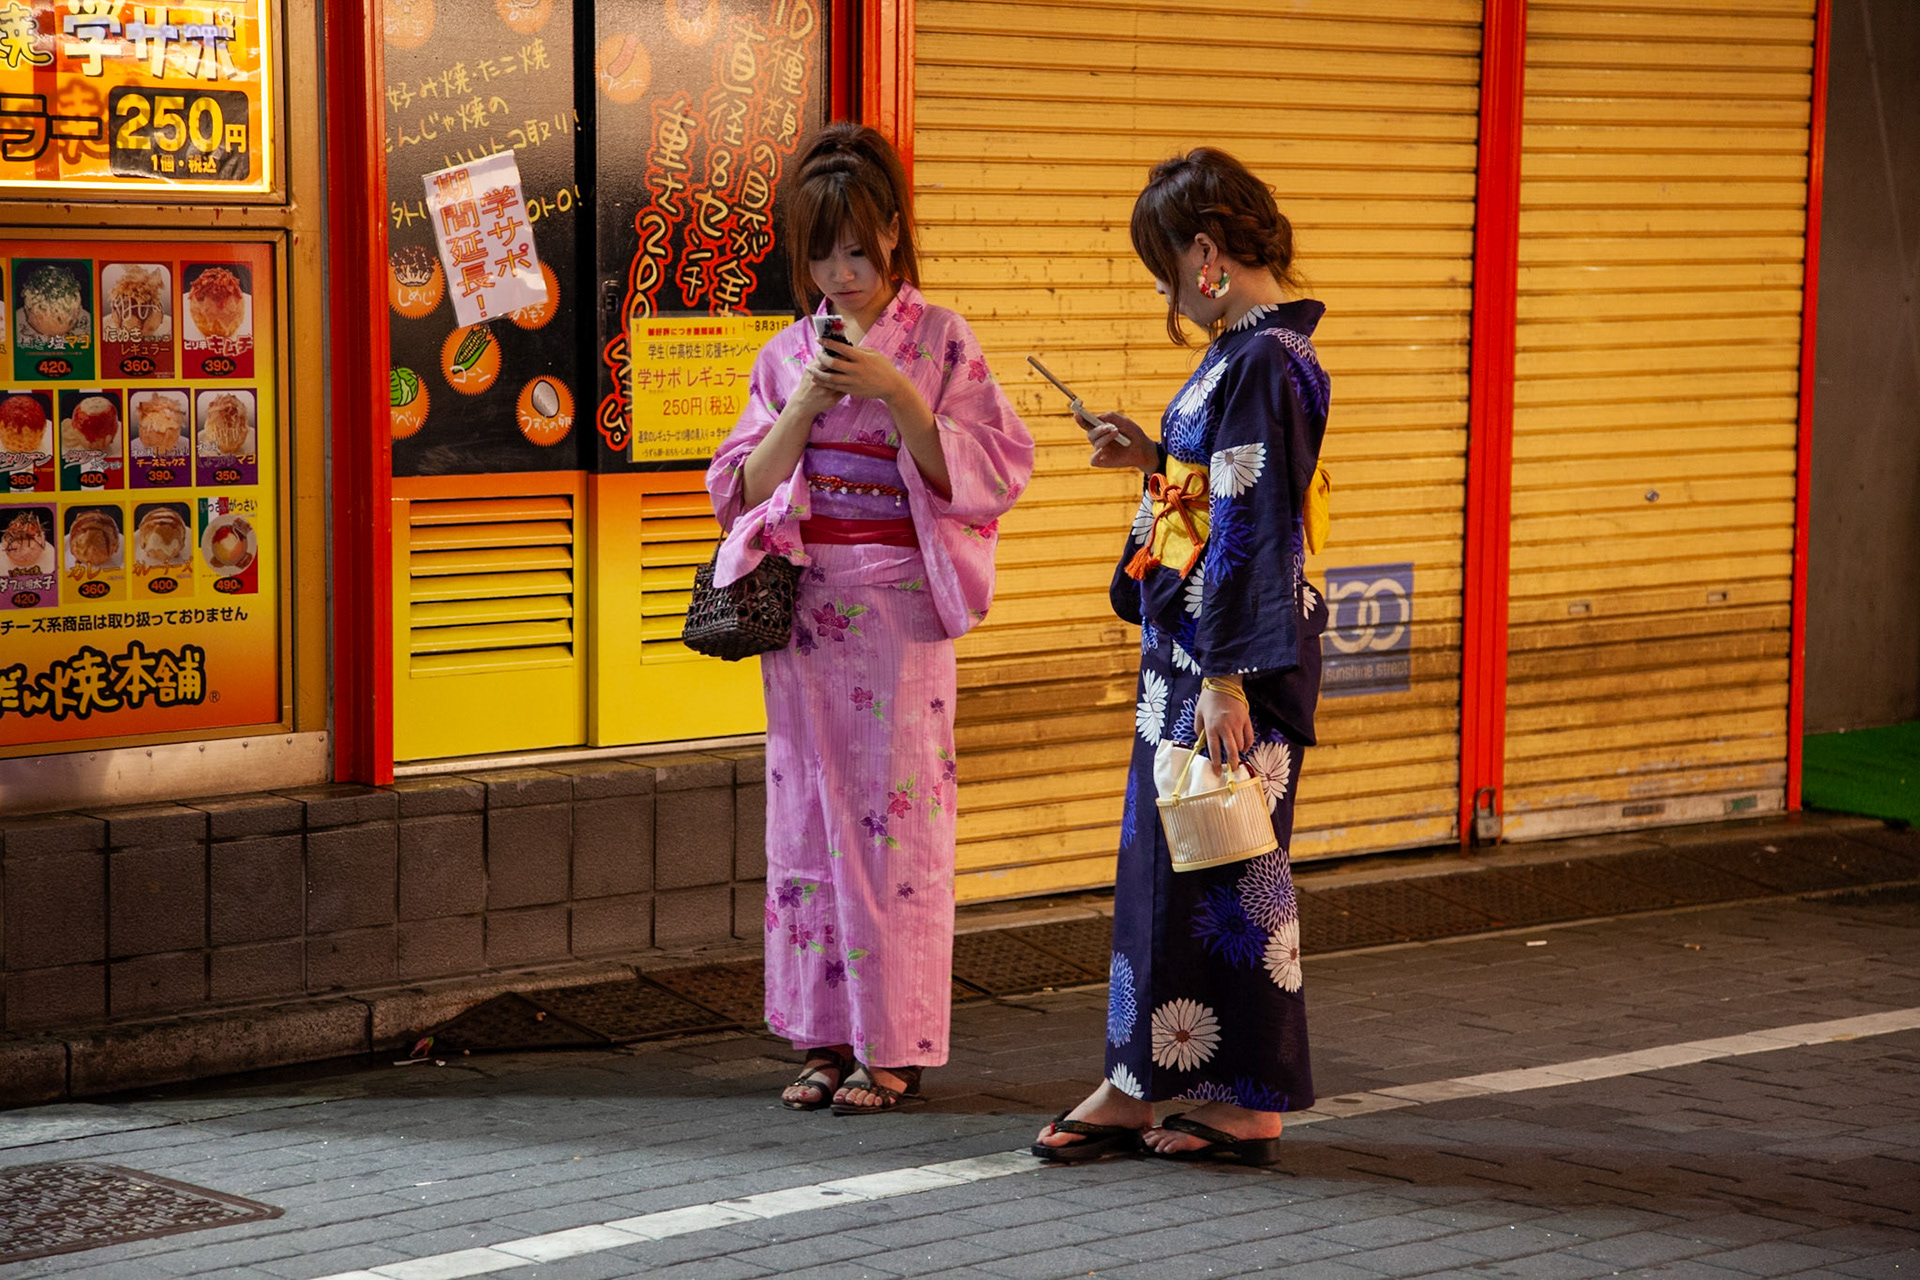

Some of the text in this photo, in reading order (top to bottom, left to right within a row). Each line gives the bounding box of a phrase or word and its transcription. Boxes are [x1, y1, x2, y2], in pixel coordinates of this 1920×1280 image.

[115, 92, 248, 153] 250円
[480, 185, 532, 278] 学サポ
[397, 288, 437, 307] しめじ
[120, 343, 170, 355] レギュラー
[449, 364, 492, 385] コーン
[637, 366, 683, 390] 学サポ
[662, 394, 741, 416] 250円(税込)
[67, 561, 122, 581] カレー
[1326, 660, 1409, 682] sunshine street
